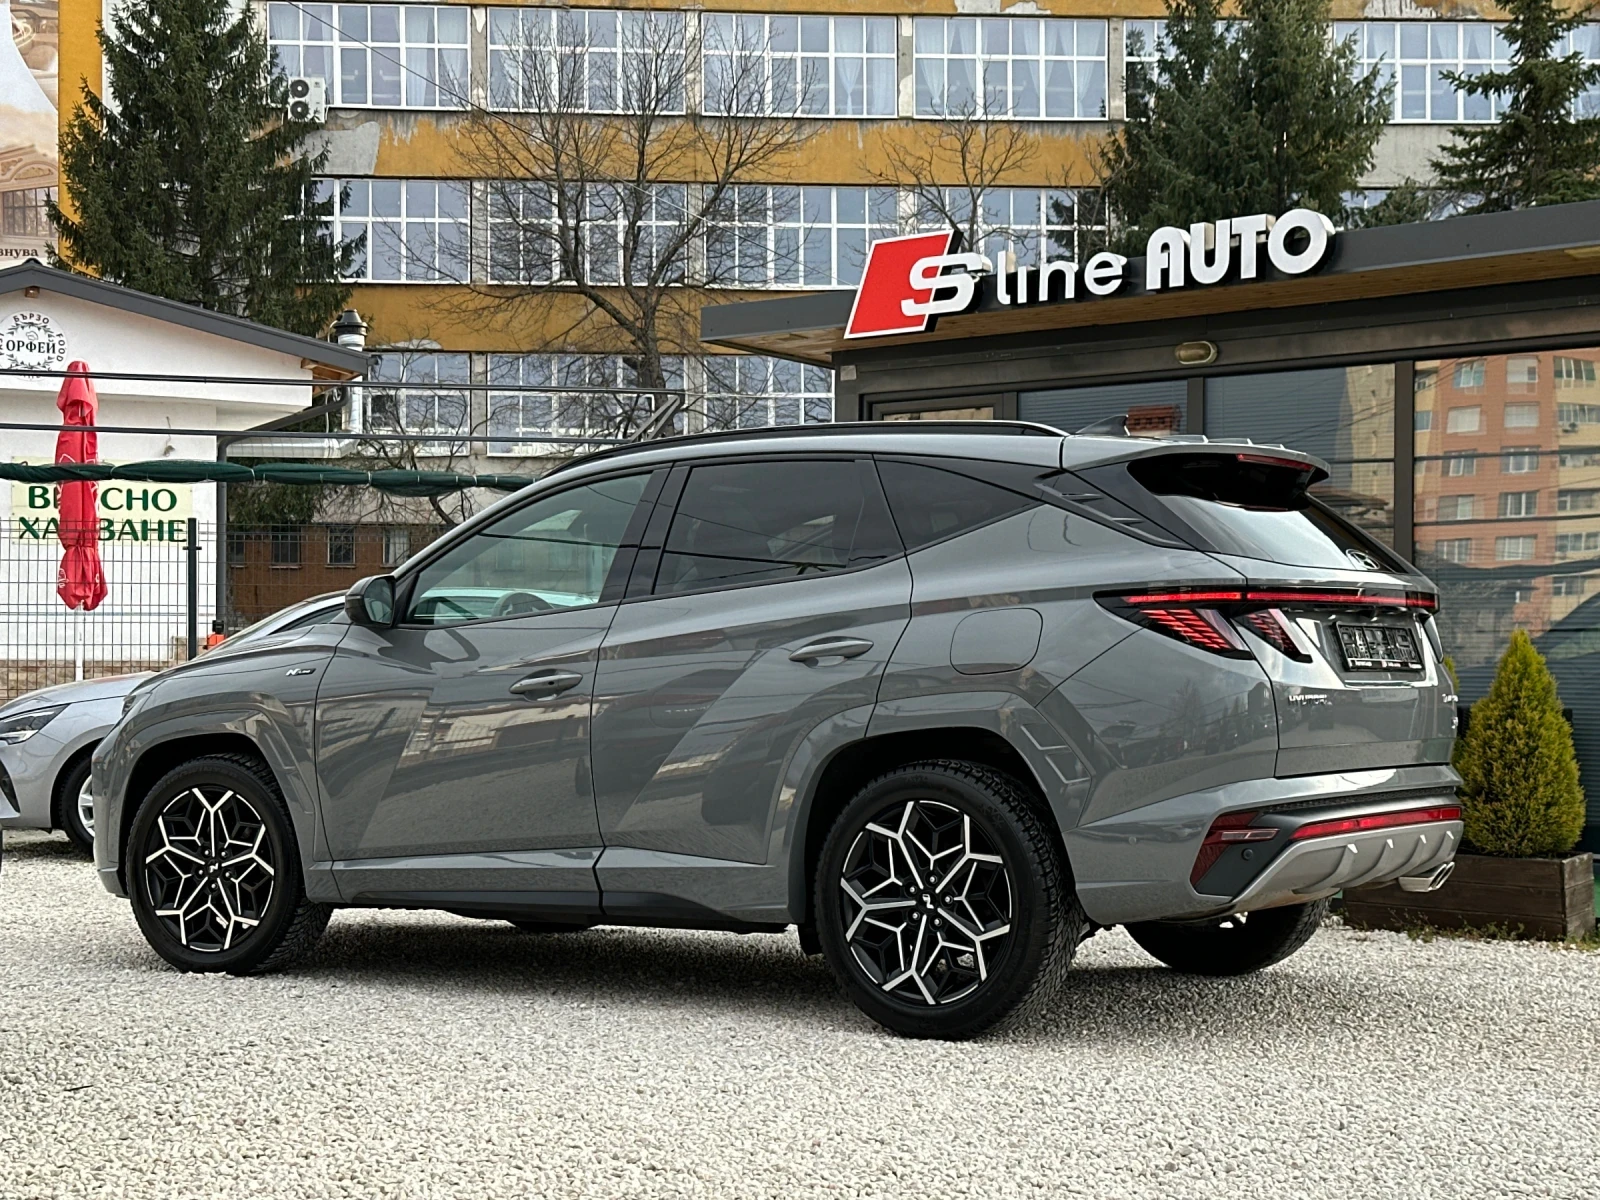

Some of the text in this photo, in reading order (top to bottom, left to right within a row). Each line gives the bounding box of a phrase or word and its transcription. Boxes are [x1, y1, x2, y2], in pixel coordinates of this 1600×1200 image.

[901, 252, 985, 317] S
[1146, 208, 1331, 290] AUTO
[12, 312, 50, 325] БЪРЗО
[6, 339, 56, 354] ОРФЕЙ
[56, 333, 66, 362] FOOD
[28, 485, 177, 512] ВСНО
[19, 516, 187, 542] ХАВАНЕ
